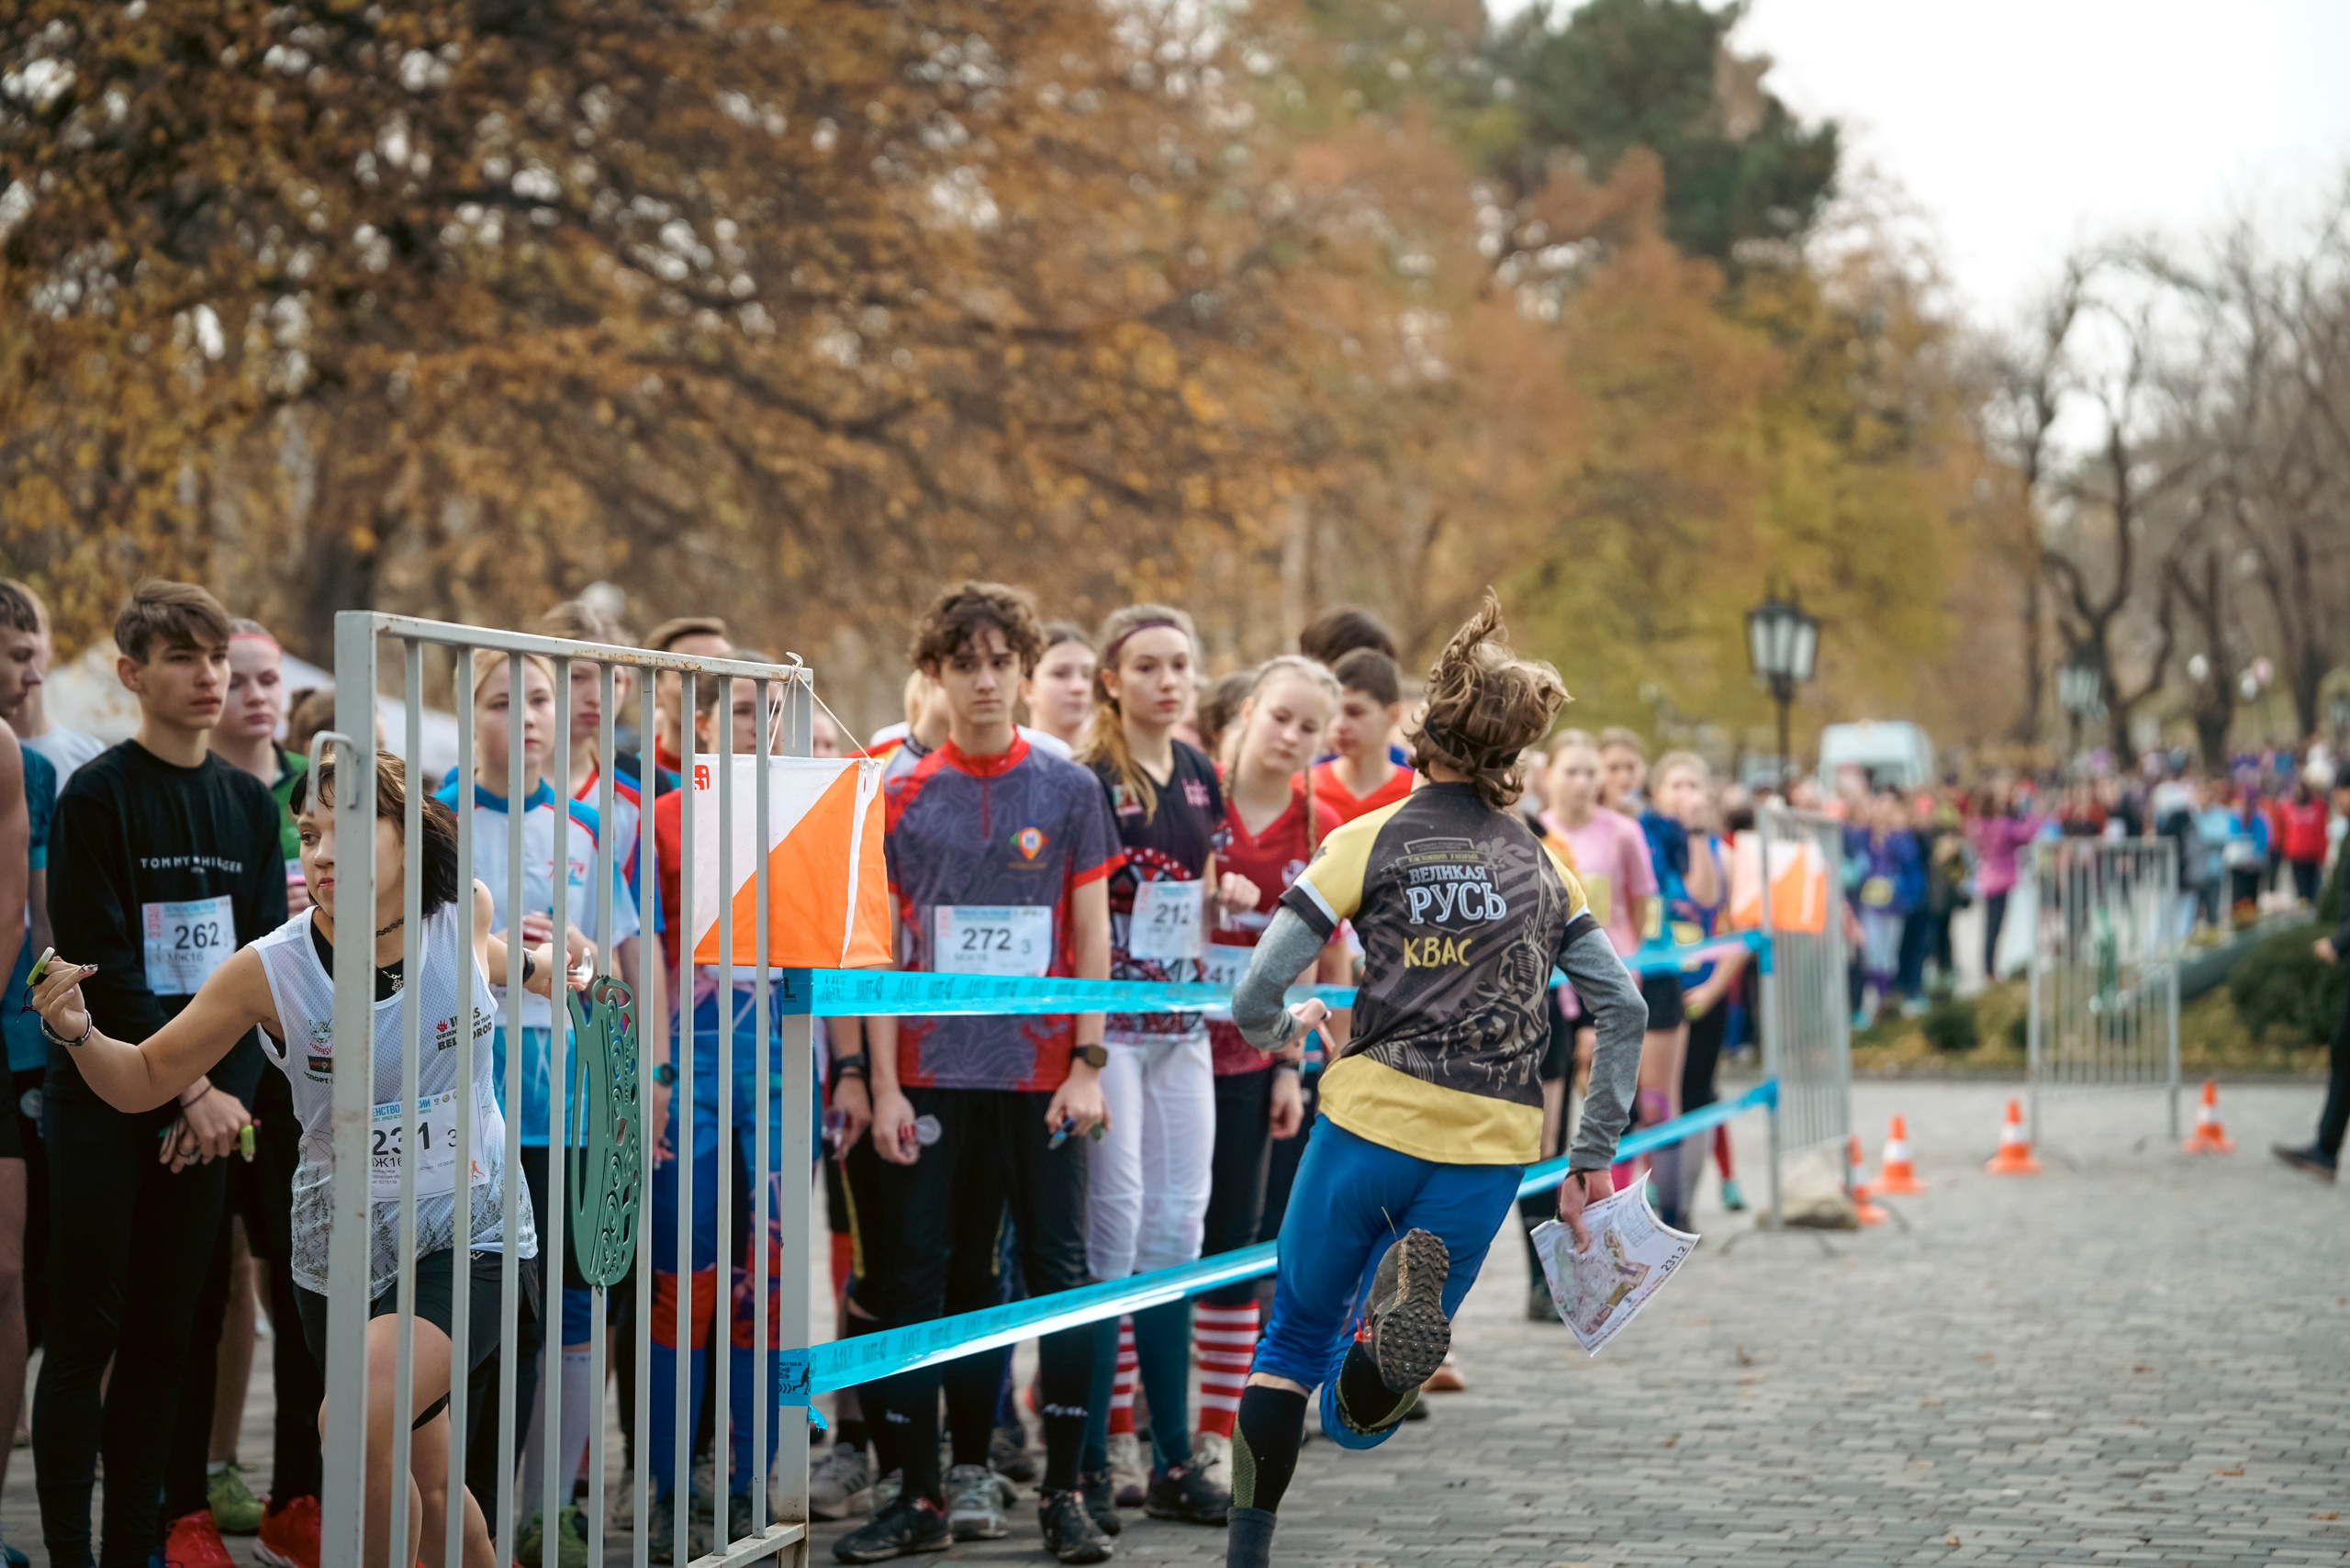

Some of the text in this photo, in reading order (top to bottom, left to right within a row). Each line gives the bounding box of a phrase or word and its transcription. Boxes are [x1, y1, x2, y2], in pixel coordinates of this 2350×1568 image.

[140, 856, 190, 869] TOMMY
[201, 856, 242, 873] HILGER
[1408, 865, 1487, 884] ВЕЛИКАЯ
[1405, 881, 1507, 924] РУСЬ
[174, 921, 220, 951] 262
[960, 927, 1013, 951] 272
[1403, 936, 1472, 969] КВАС
[1661, 1246, 1687, 1271] 231.2
